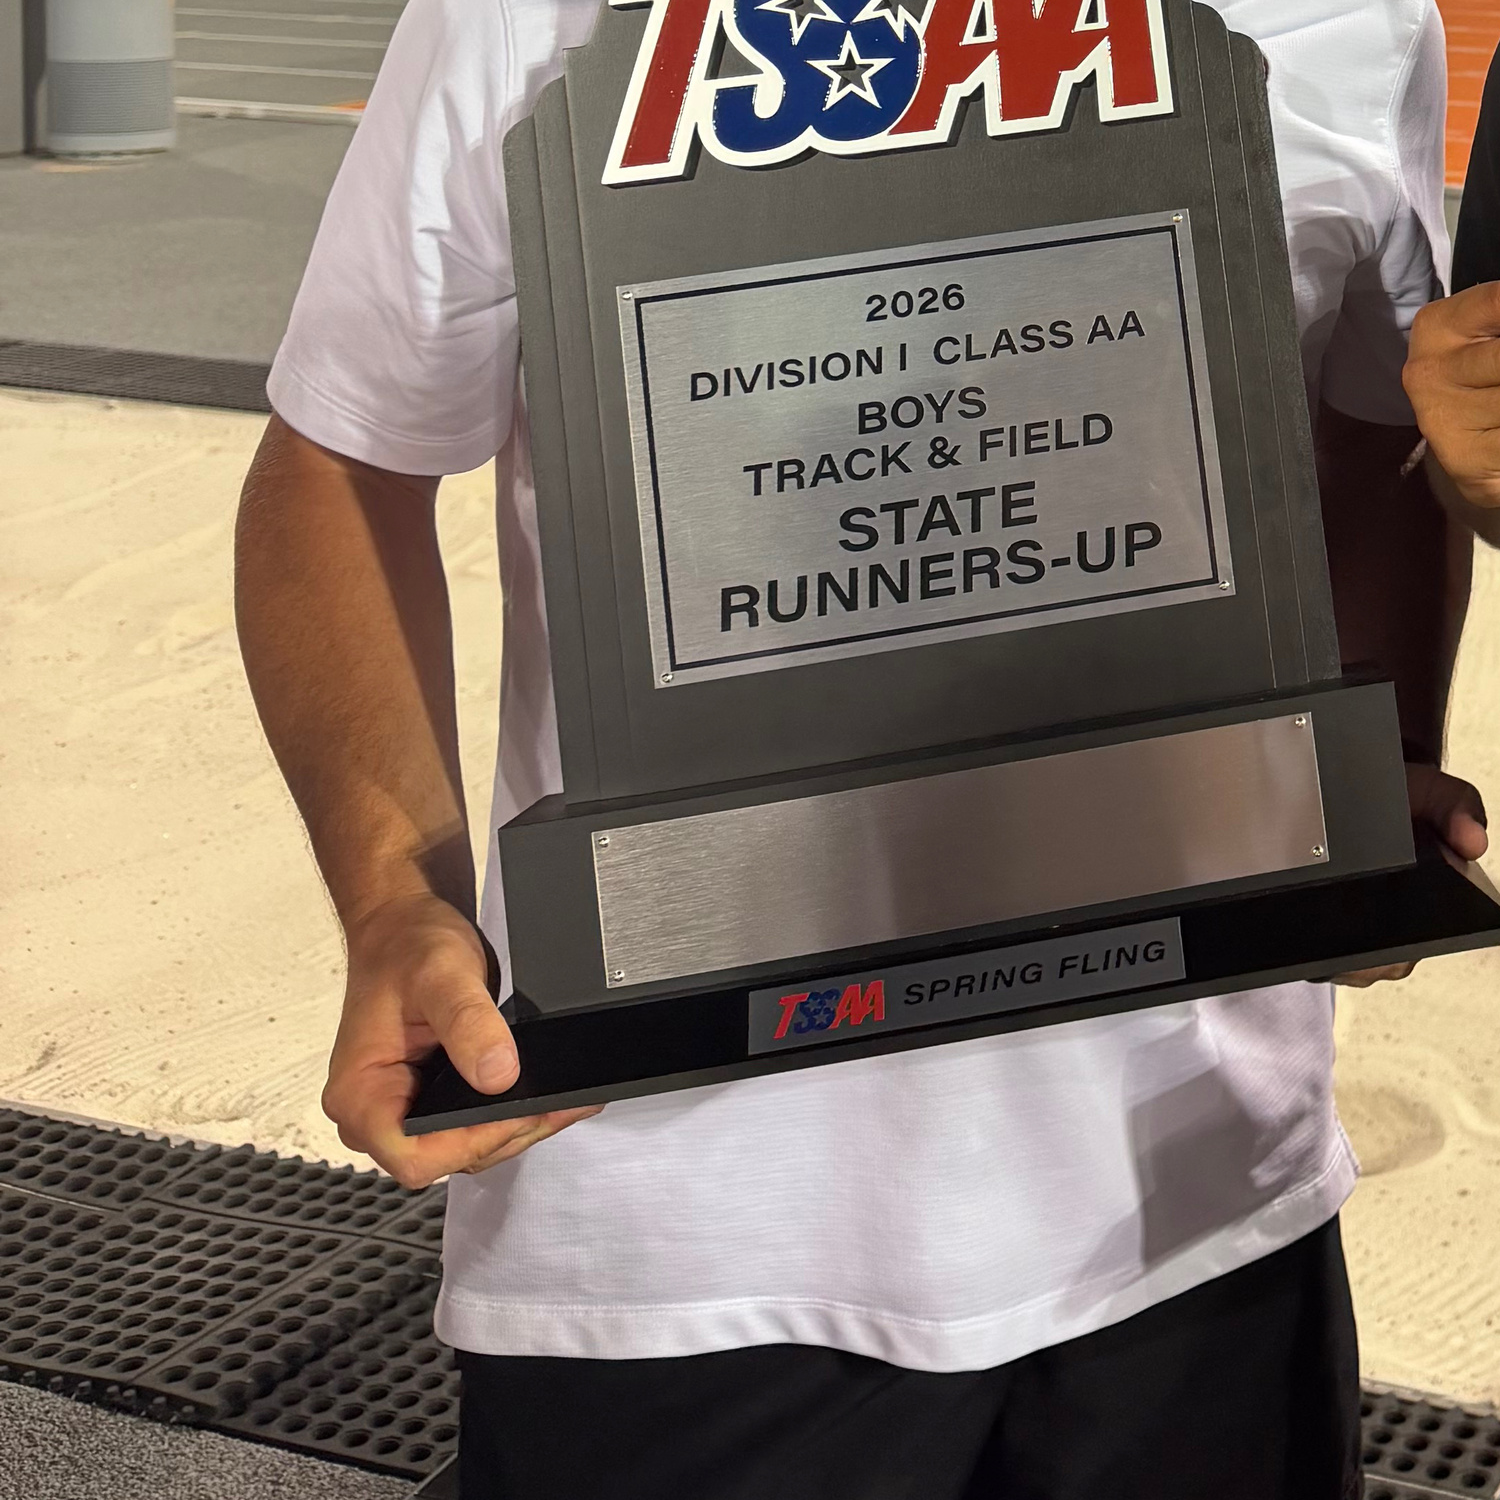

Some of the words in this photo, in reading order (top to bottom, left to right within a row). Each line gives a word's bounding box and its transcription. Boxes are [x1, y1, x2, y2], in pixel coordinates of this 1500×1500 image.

[866, 283, 966, 322] 2026
[690, 346, 883, 402] DIVISION
[899, 343, 907, 371] I
[933, 320, 1074, 365] CLASS
[1086, 310, 1146, 345] AA
[858, 386, 987, 435] BOYS
[743, 441, 912, 496] TRACK
[927, 436, 962, 470] &
[979, 413, 1113, 462] FIELD
[838, 481, 1038, 552] STATE
[720, 521, 1162, 632] RUNNERS-UP
[903, 962, 1043, 1007] SPRING
[1058, 940, 1166, 979] FLING
